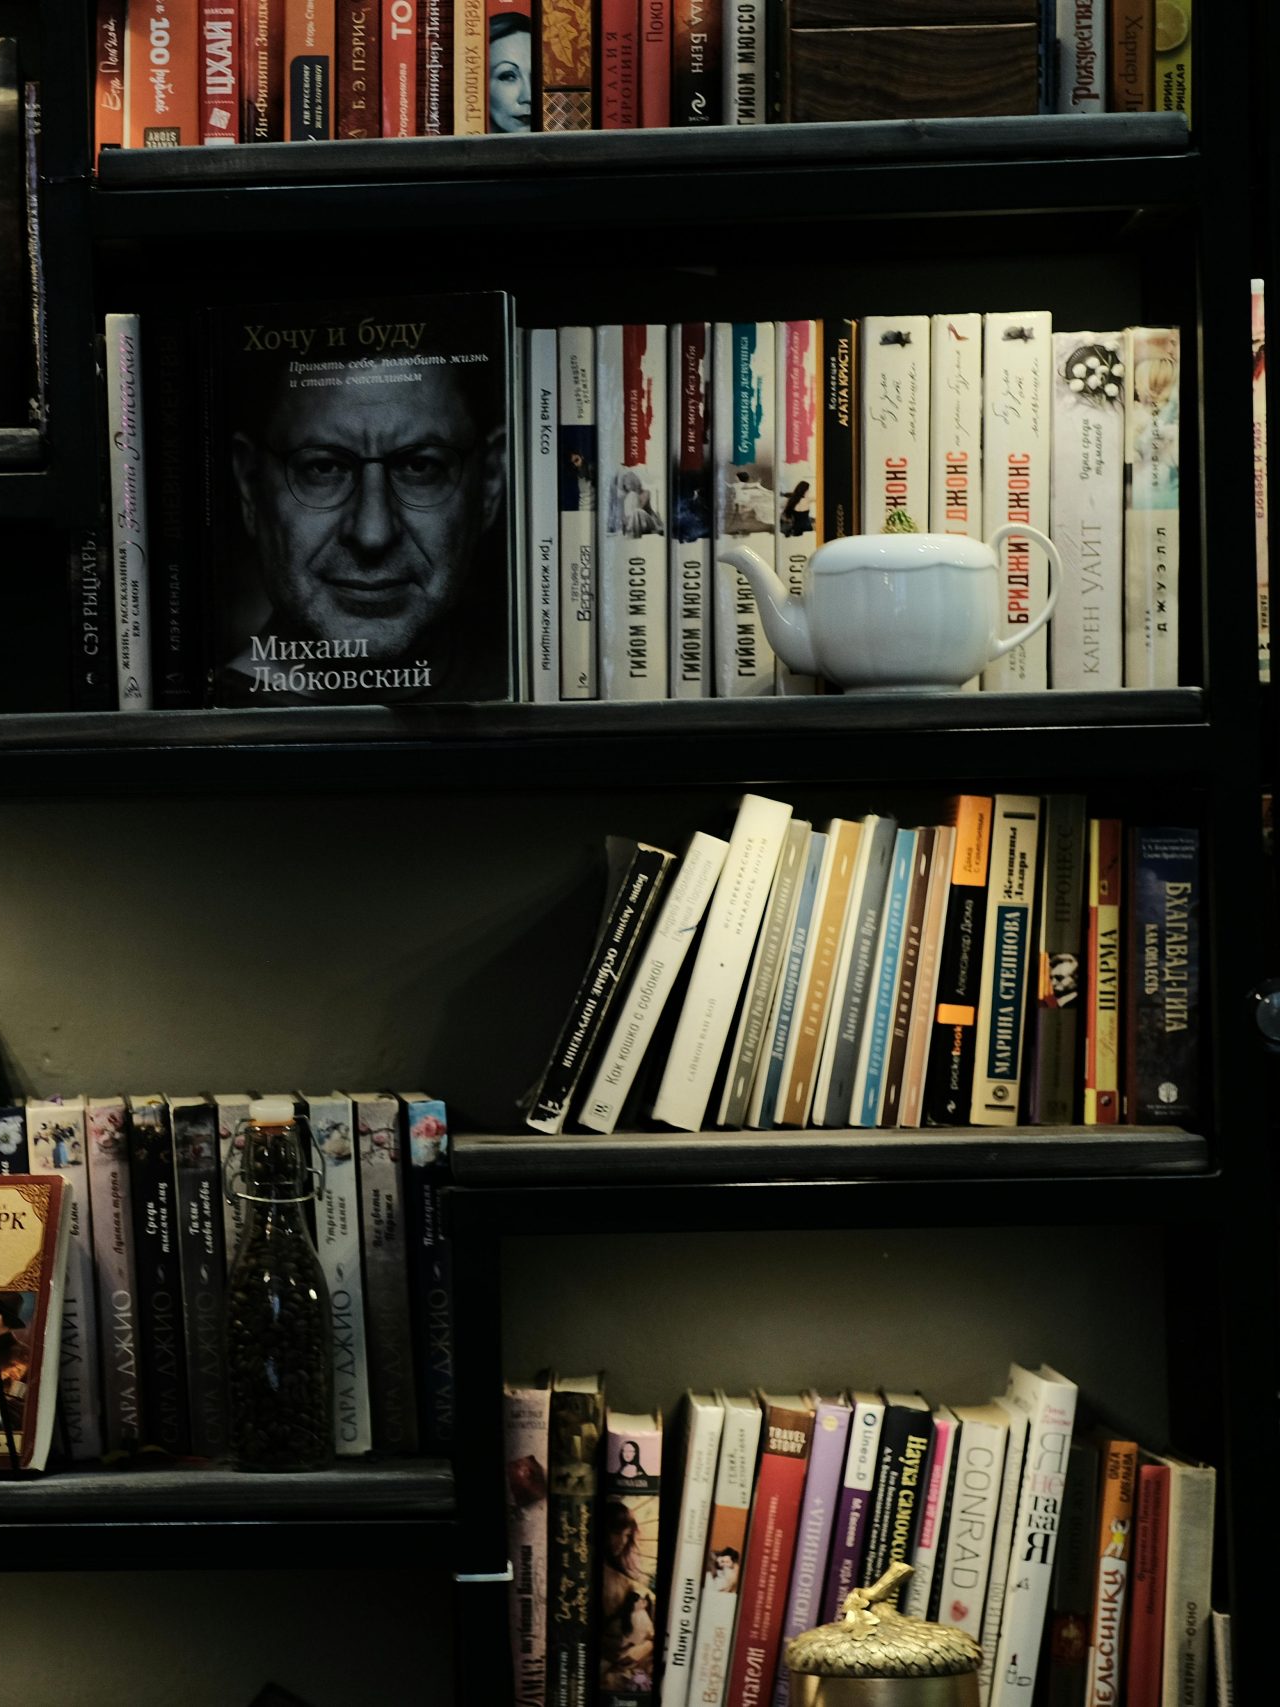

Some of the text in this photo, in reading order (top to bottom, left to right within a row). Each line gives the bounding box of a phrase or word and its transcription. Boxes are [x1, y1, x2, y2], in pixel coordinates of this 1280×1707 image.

[149, 18, 171, 65] 100
[204, 20, 235, 94] ЦХАЙ
[736, 4, 756, 63] МЮССО
[1118, 14, 1138, 83] Харпер
[1163, 70, 1174, 111] ИРИНА
[242, 316, 428, 356] Хочу и буду
[626, 388, 641, 438] ангела
[734, 336, 753, 454] бумажная девушка
[837, 337, 850, 427] АГАТА КРИСТИ
[945, 451, 969, 522] ДЖОНС
[1007, 453, 1031, 525] ДЖОНС
[538, 389, 554, 672] Анна Три жизни женщины
[628, 557, 648, 680] ГИЙОМ МЮССО
[682, 560, 703, 682] ГИЙОМ МЮССО
[1078, 518, 1104, 675] КАРЕН УАЙТ
[82, 622, 99, 657] СЭР
[249, 659, 433, 693] Лабковский
[250, 634, 369, 662] Михаил
[736, 623, 757, 678] ГИЙОМ
[1052, 824, 1077, 924] ПРОЦЕСС
[559, 871, 649, 1069] Борис Акунин ОСОБЫЕ ПОРУЧЕНИЯ
[954, 898, 976, 995] Александр Дюма
[1097, 929, 1119, 1012] ШАРМА
[1143, 923, 1161, 996] КАК ОНА ЕСТЬ
[1162, 880, 1193, 1033] БХАГАВАД-ГИТА
[604, 957, 668, 1086] Как кошка с собакой
[992, 910, 1022, 1076] МАРИНА СТЕПНОВА
[144, 1201, 159, 1237] Среди
[110, 1289, 140, 1440] САРА ДЖИО
[150, 1290, 179, 1443] САРА ДЖИО
[195, 1289, 221, 1378] ДЖИО
[331, 1290, 359, 1443] САРА ДЖИО
[426, 1288, 454, 1378] ДЖИО
[768, 1426, 807, 1444] TRAVEL
[769, 1437, 804, 1454] STORY
[891, 1432, 930, 1489] Наука
[950, 1445, 995, 1590] CONRAD
[670, 1577, 698, 1667] Минус один
[1182, 1600, 1200, 1637] ОКНО
